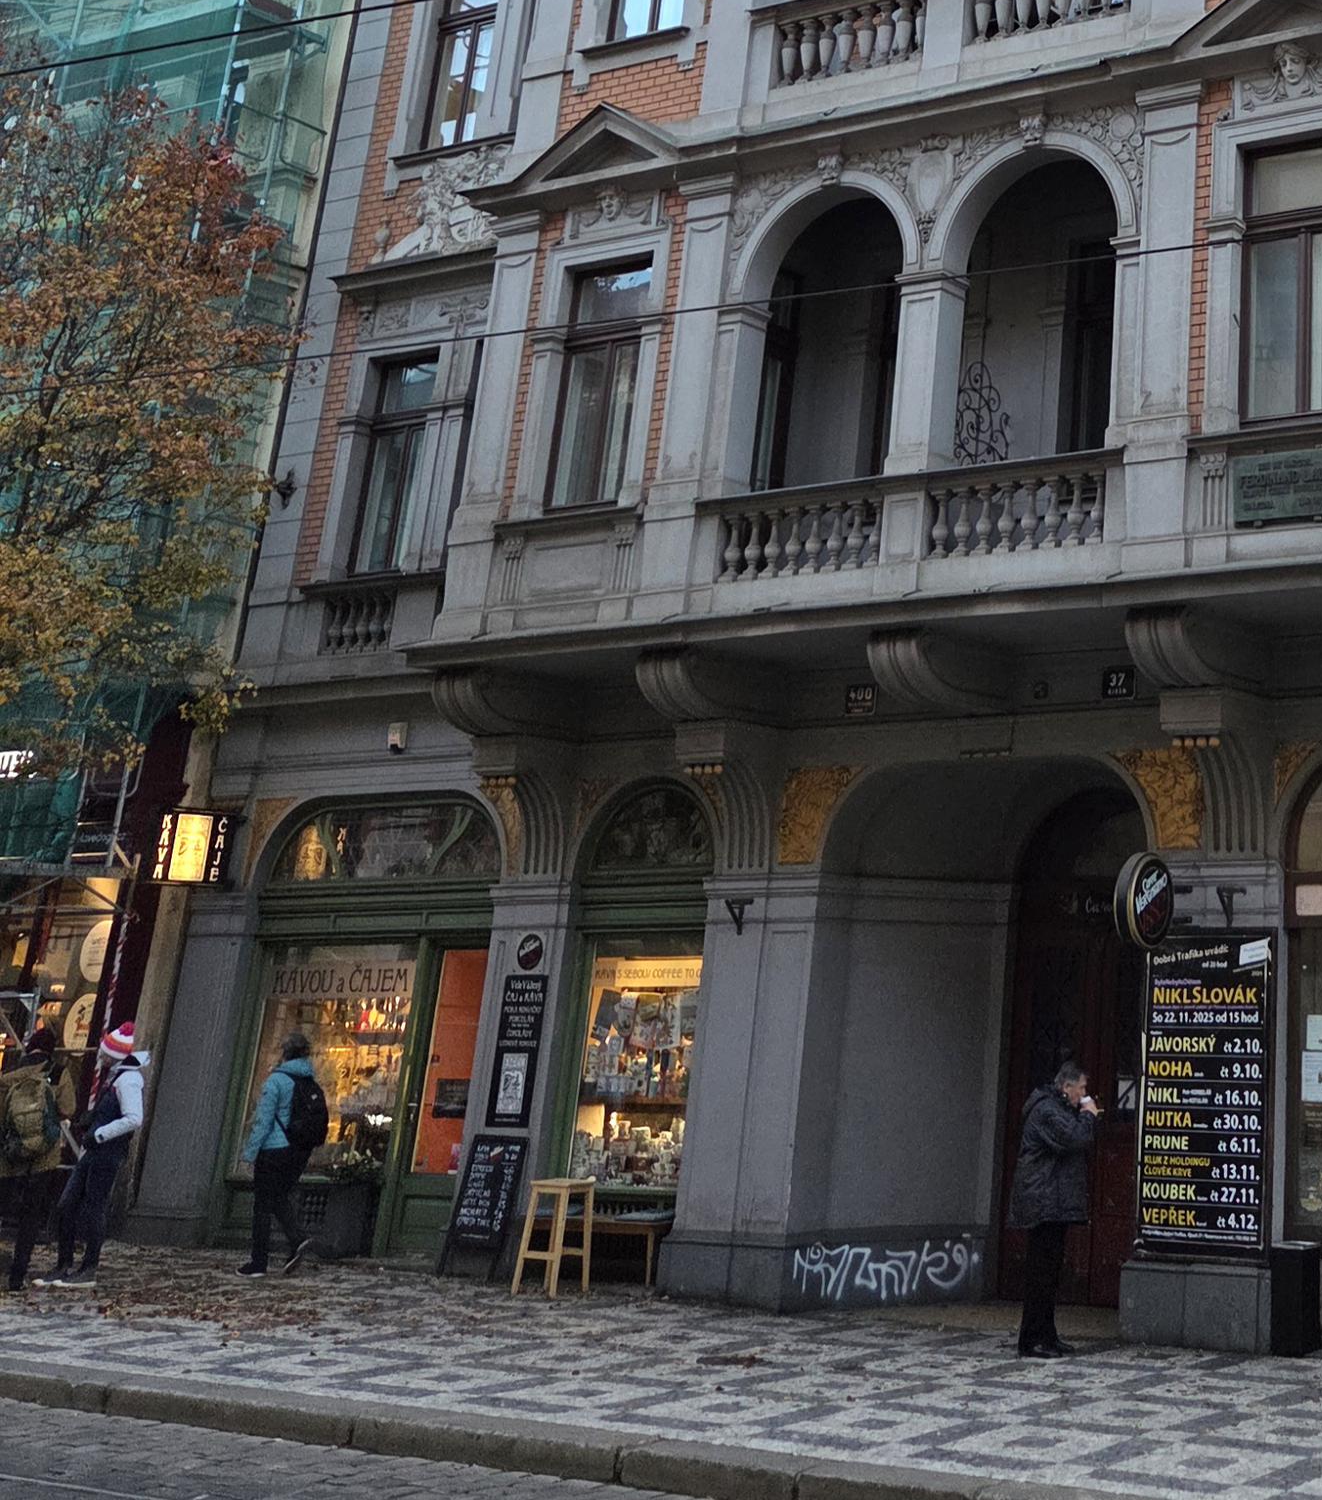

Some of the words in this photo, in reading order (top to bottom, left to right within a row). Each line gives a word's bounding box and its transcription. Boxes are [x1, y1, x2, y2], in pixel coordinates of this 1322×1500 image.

[1109, 672, 1126, 687] 37
[209, 816, 229, 882] ČAJE
[1177, 948, 1204, 960] Trafika
[272, 966, 335, 994] KÁVOU
[336, 975, 346, 993] a
[349, 963, 409, 993] ČAJEM
[685, 967, 696, 979] TO
[1152, 1011, 1163, 1023] So
[1164, 1011, 1177, 1023] 22.
[1179, 1011, 1192, 1023] 11.
[1193, 1011, 1214, 1023] 2025
[1215, 1011, 1227, 1023] od
[1229, 1011, 1240, 1023] 15
[1240, 1011, 1259, 1023] hod
[1149, 1033, 1217, 1053] JAVORSKÝ
[1223, 1041, 1232, 1053] čt
[1233, 1038, 1263, 1054] 2.10.
[1148, 1060, 1193, 1077] NOHA
[1220, 1066, 1229, 1078] čt
[1232, 1062, 1263, 1079] 9.10.
[1147, 1087, 1181, 1103] NIKL
[1214, 1093, 1223, 1105] čt
[1225, 1090, 1262, 1106] 16.10.
[1145, 1111, 1192, 1128] HUTKA
[1213, 1117, 1222, 1129] čt
[1222, 1114, 1262, 1130] 30.10.
[1144, 1134, 1190, 1150] PRUNE
[1217, 1140, 1227, 1152] čt
[1229, 1137, 1261, 1153] 6.11.
[1144, 1155, 1163, 1165] KLUK
[1163, 1156, 1168, 1165] Z
[1169, 1156, 1211, 1167] HOLDINGU
[1143, 1165, 1172, 1177] ČLOVĚK
[1211, 1167, 1220, 1179] čt
[1222, 1164, 1260, 1180] 13.11.
[1142, 1182, 1196, 1200] KOUBEK
[1210, 1190, 1219, 1202] čt
[1220, 1187, 1259, 1204] 27.11.
[1142, 1206, 1196, 1226] VEPŘEK
[1217, 1216, 1226, 1228] čt
[1227, 1213, 1259, 1230] 4.12.
